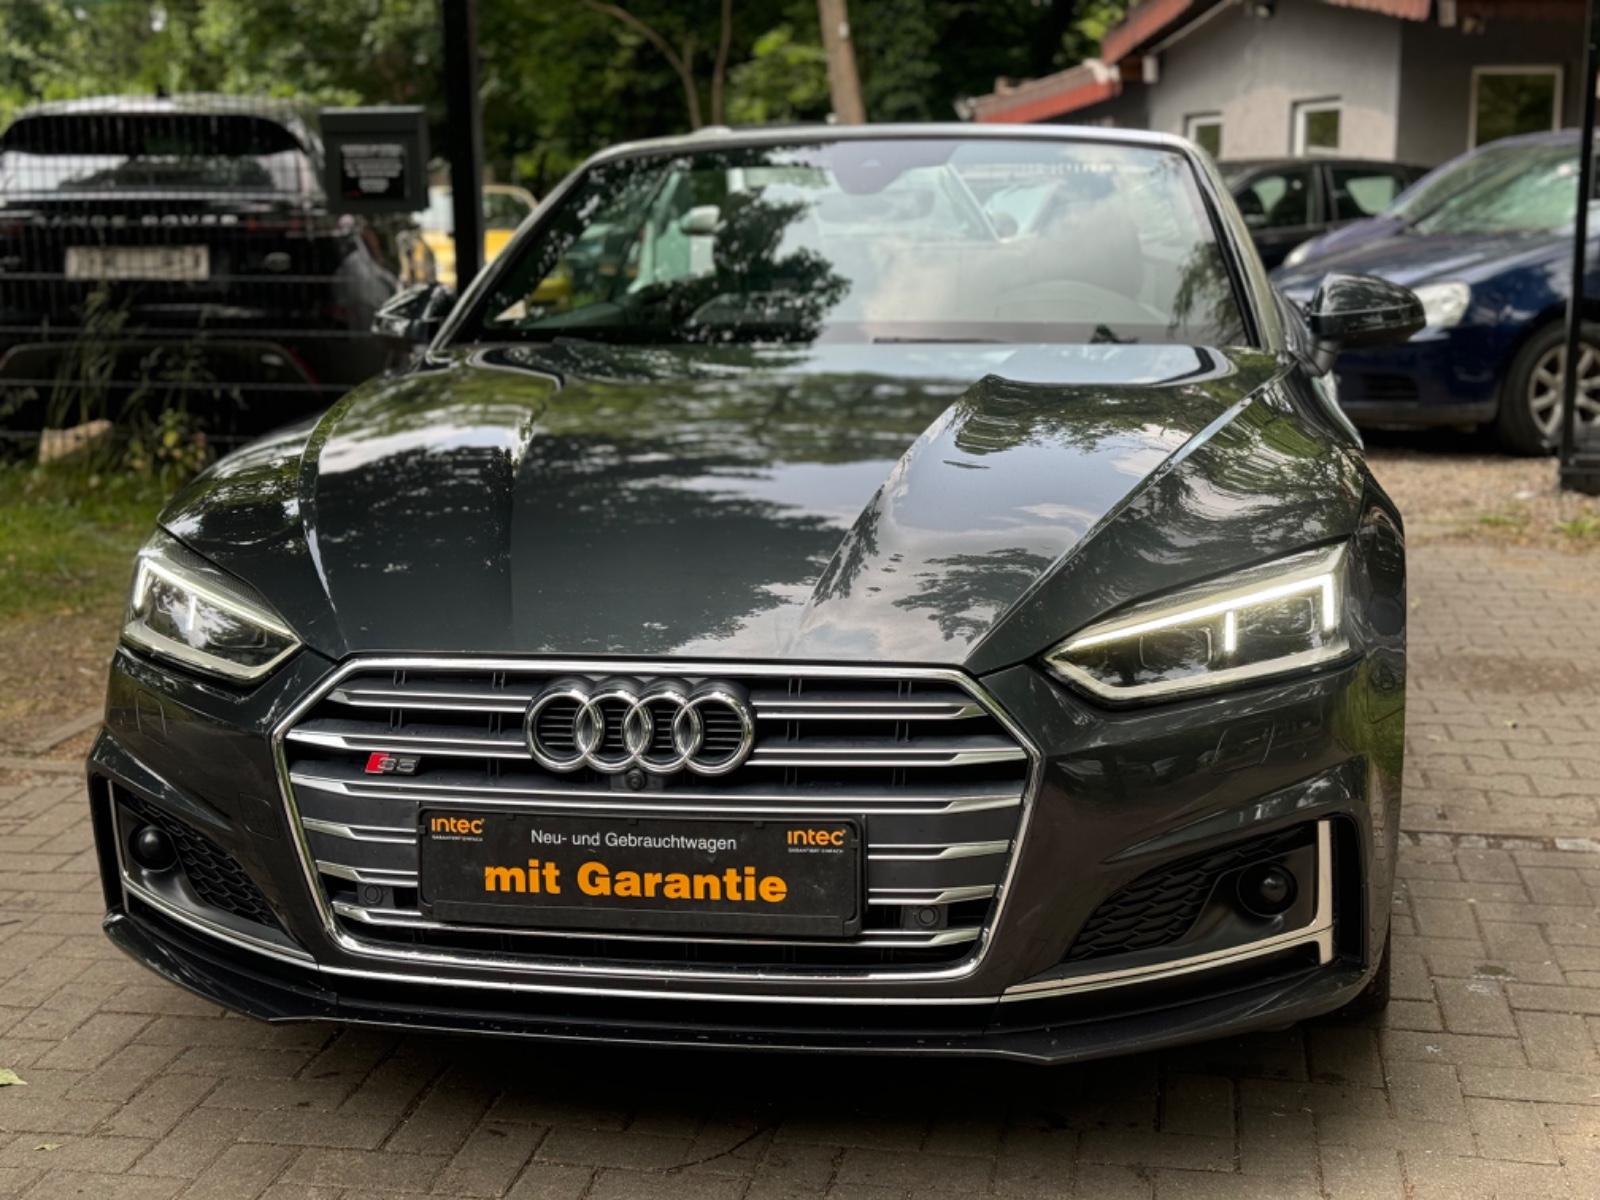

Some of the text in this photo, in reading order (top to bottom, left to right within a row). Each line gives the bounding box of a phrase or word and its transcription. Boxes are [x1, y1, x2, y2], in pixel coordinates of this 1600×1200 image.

[431, 816, 484, 834] intec
[531, 829, 737, 853] Neu- und Gebrauchtwagen
[787, 829, 845, 846] intec
[484, 858, 788, 904] mit Garantie
